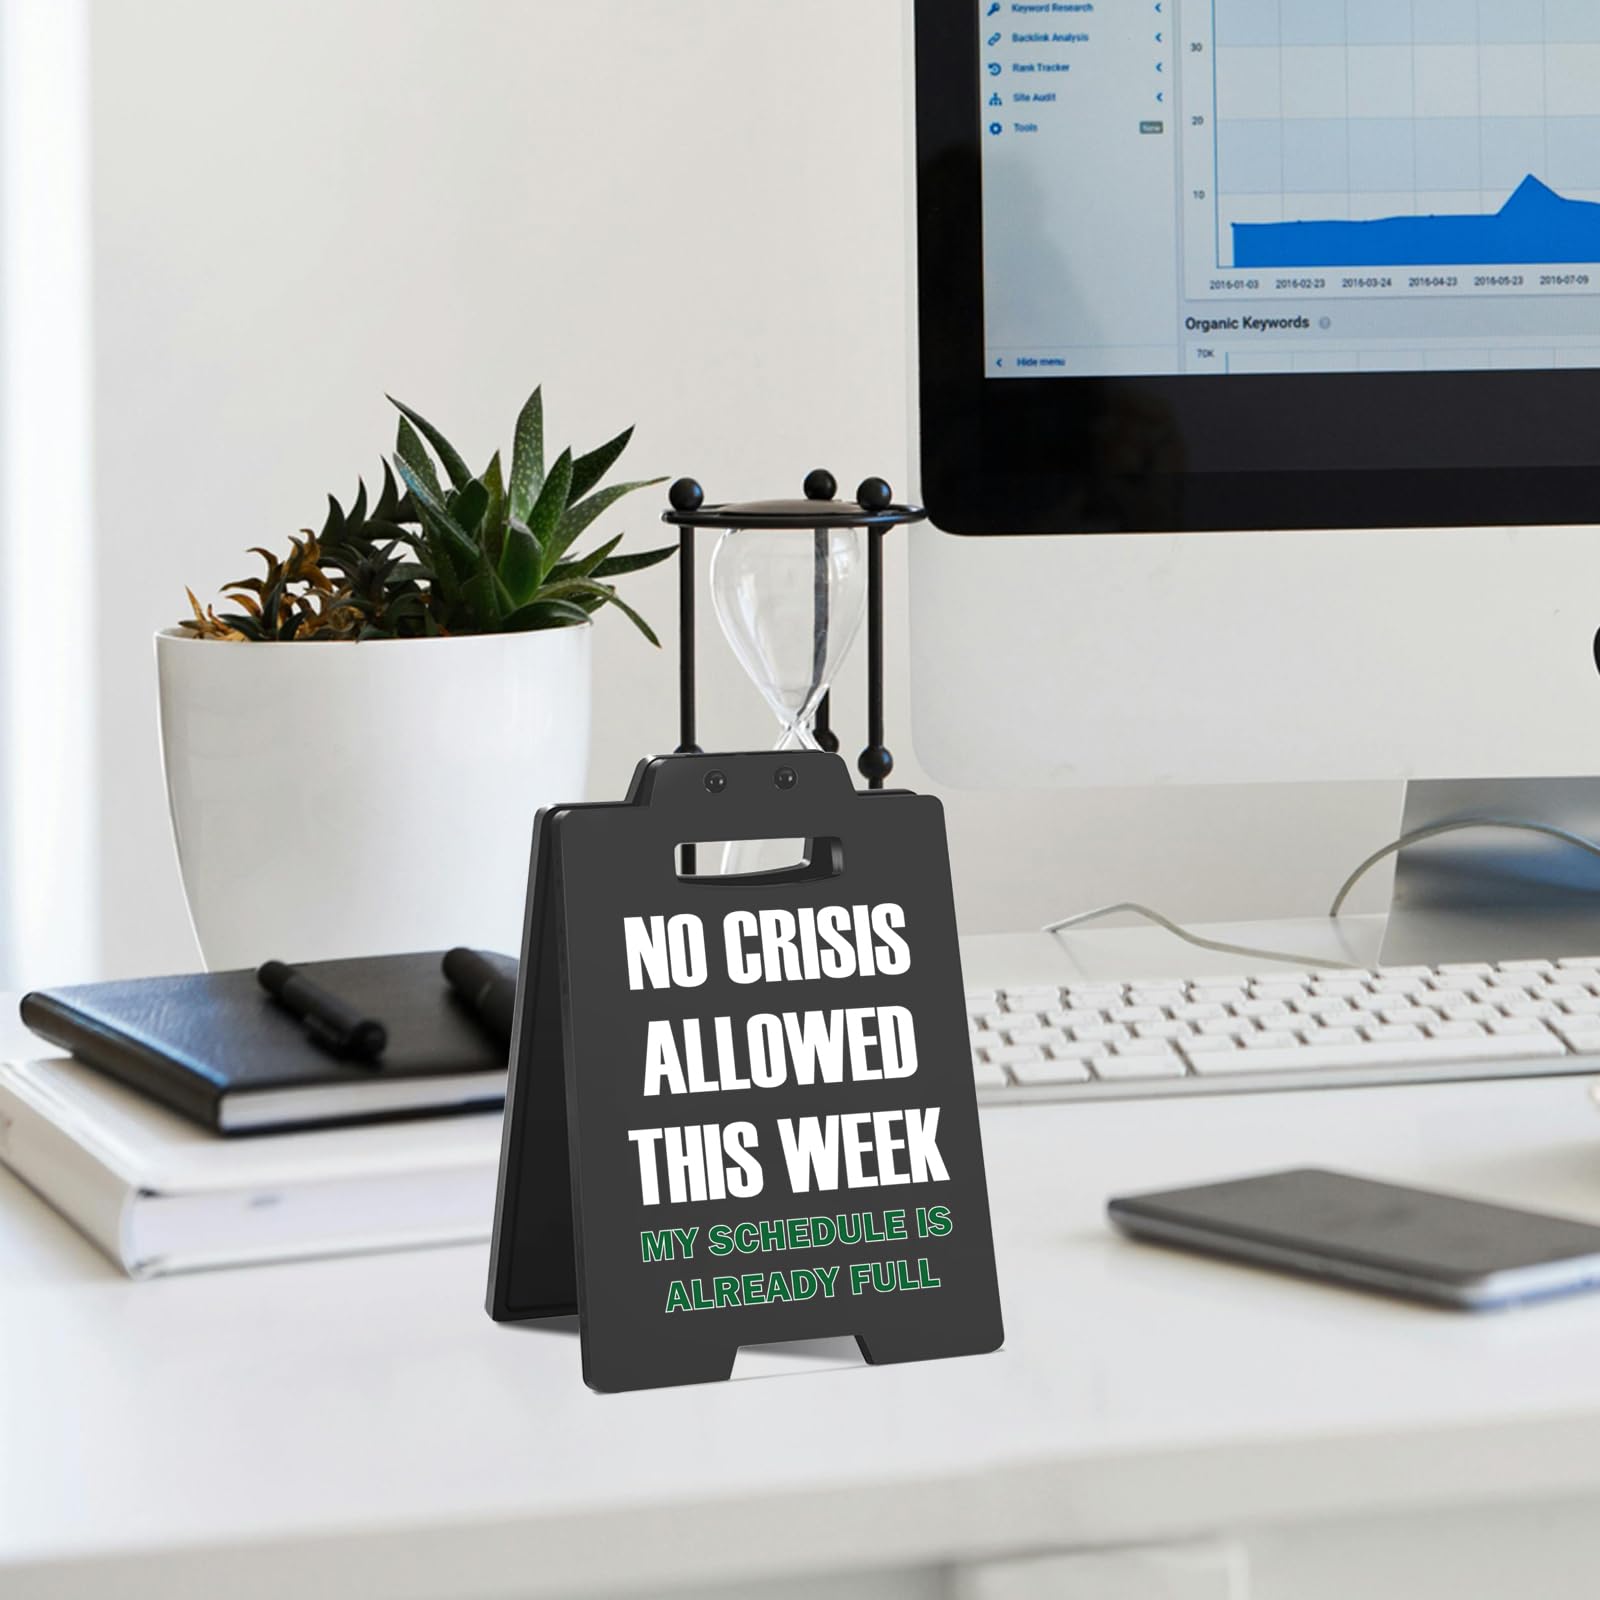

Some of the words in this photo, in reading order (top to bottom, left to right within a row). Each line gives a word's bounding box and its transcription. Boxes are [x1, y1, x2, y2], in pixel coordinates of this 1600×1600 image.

[1011, 3, 1050, 13] Keyword
[1052, 3, 1093, 12] Research
[1012, 33, 1049, 42] Backlink
[1052, 32, 1089, 43] Analysis
[1191, 43, 1203, 52] 30
[1012, 63, 1035, 72] Rank
[1037, 62, 1070, 72] Tracker
[1013, 93, 1031, 102] Site
[1032, 92, 1056, 102] Audit
[1192, 115, 1204, 126] 20
[1014, 122, 1038, 133] Tools
[1193, 190, 1205, 200] 10
[1209, 279, 1260, 290] 2016-01-03
[1275, 278, 1326, 289] 2016-02-23
[1342, 277, 1392, 288] 2016-03-24
[1408, 276, 1458, 287] 2016-04-23
[1539, 274, 1590, 285] 2016-07-09
[1185, 316, 1239, 333] Organic
[1242, 315, 1310, 332] Keywords
[1197, 348, 1215, 359] 70K
[1016, 357, 1038, 367] Hide
[623, 913, 708, 991] NO
[723, 902, 912, 985] CRISIS
[643, 1005, 919, 1096] ALLOWED
[628, 1121, 764, 1206] THIS
[777, 1107, 951, 1193] WEEK
[640, 1227, 699, 1263] MY
[708, 1209, 906, 1256] SCHEDULE
[915, 1205, 954, 1238] IS
[664, 1265, 840, 1314] ALREADY
[849, 1257, 941, 1295] FULL
